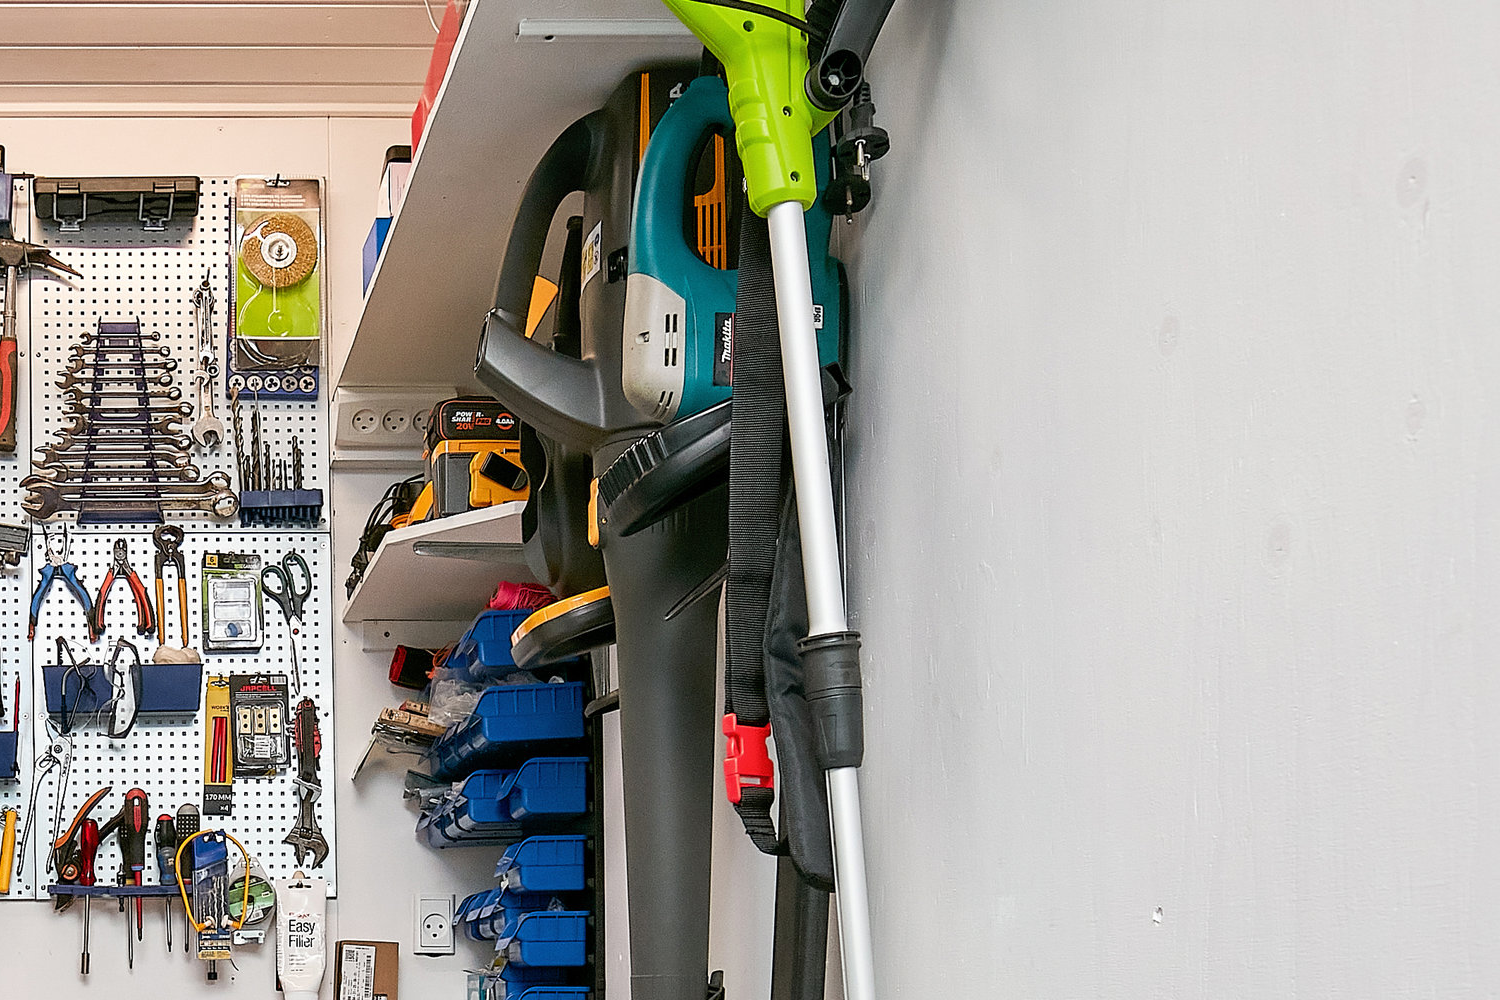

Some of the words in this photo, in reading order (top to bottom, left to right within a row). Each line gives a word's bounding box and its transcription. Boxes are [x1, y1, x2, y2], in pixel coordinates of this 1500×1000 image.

[721, 317, 732, 363] makita
[205, 793, 218, 801] 170
[218, 793, 231, 801] MM
[288, 919, 316, 935] Easy
[288, 934, 316, 948] Filler
